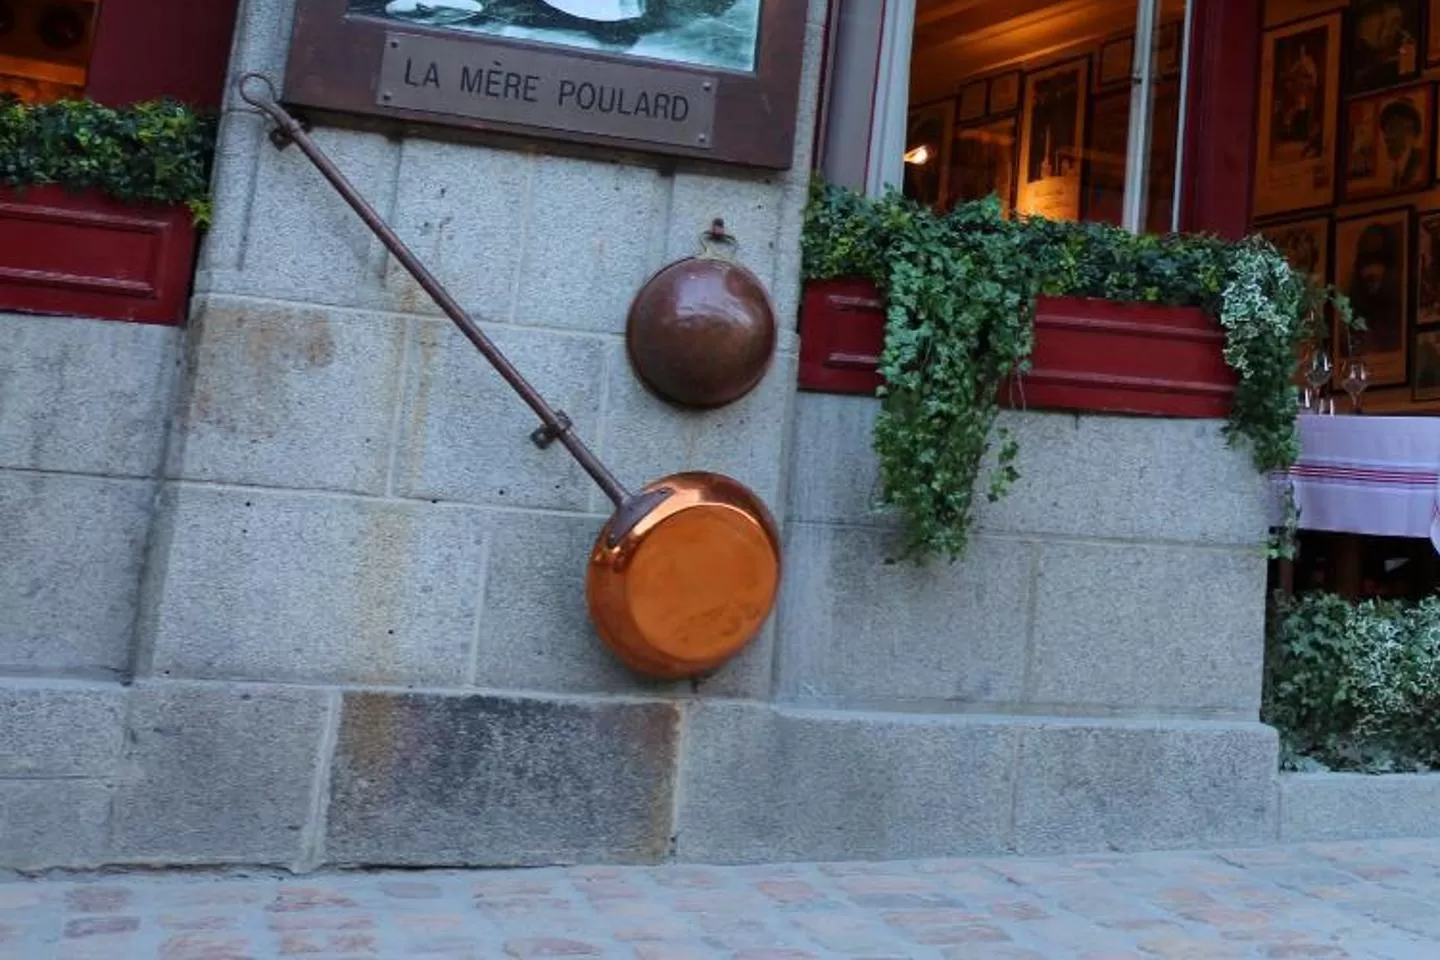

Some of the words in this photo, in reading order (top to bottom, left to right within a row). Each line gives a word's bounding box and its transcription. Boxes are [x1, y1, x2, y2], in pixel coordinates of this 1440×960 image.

[404, 56, 440, 89] LA
[460, 60, 541, 103] MÈRE
[558, 79, 689, 122] POULARD
